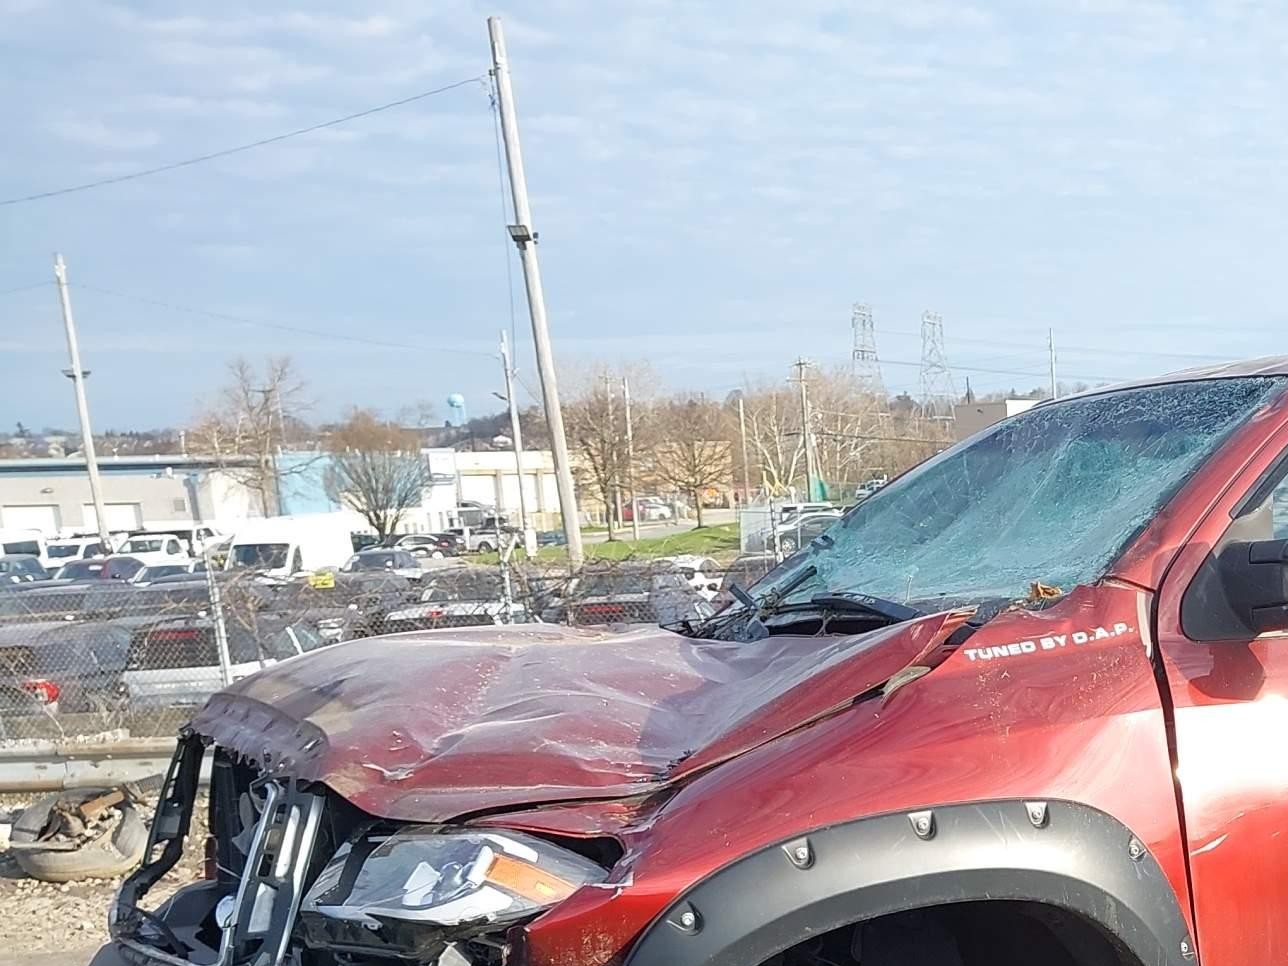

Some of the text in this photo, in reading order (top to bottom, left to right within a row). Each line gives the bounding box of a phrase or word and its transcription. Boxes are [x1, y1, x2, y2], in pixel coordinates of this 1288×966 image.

[963, 622, 1135, 661] TUNED BY D.A.P.
